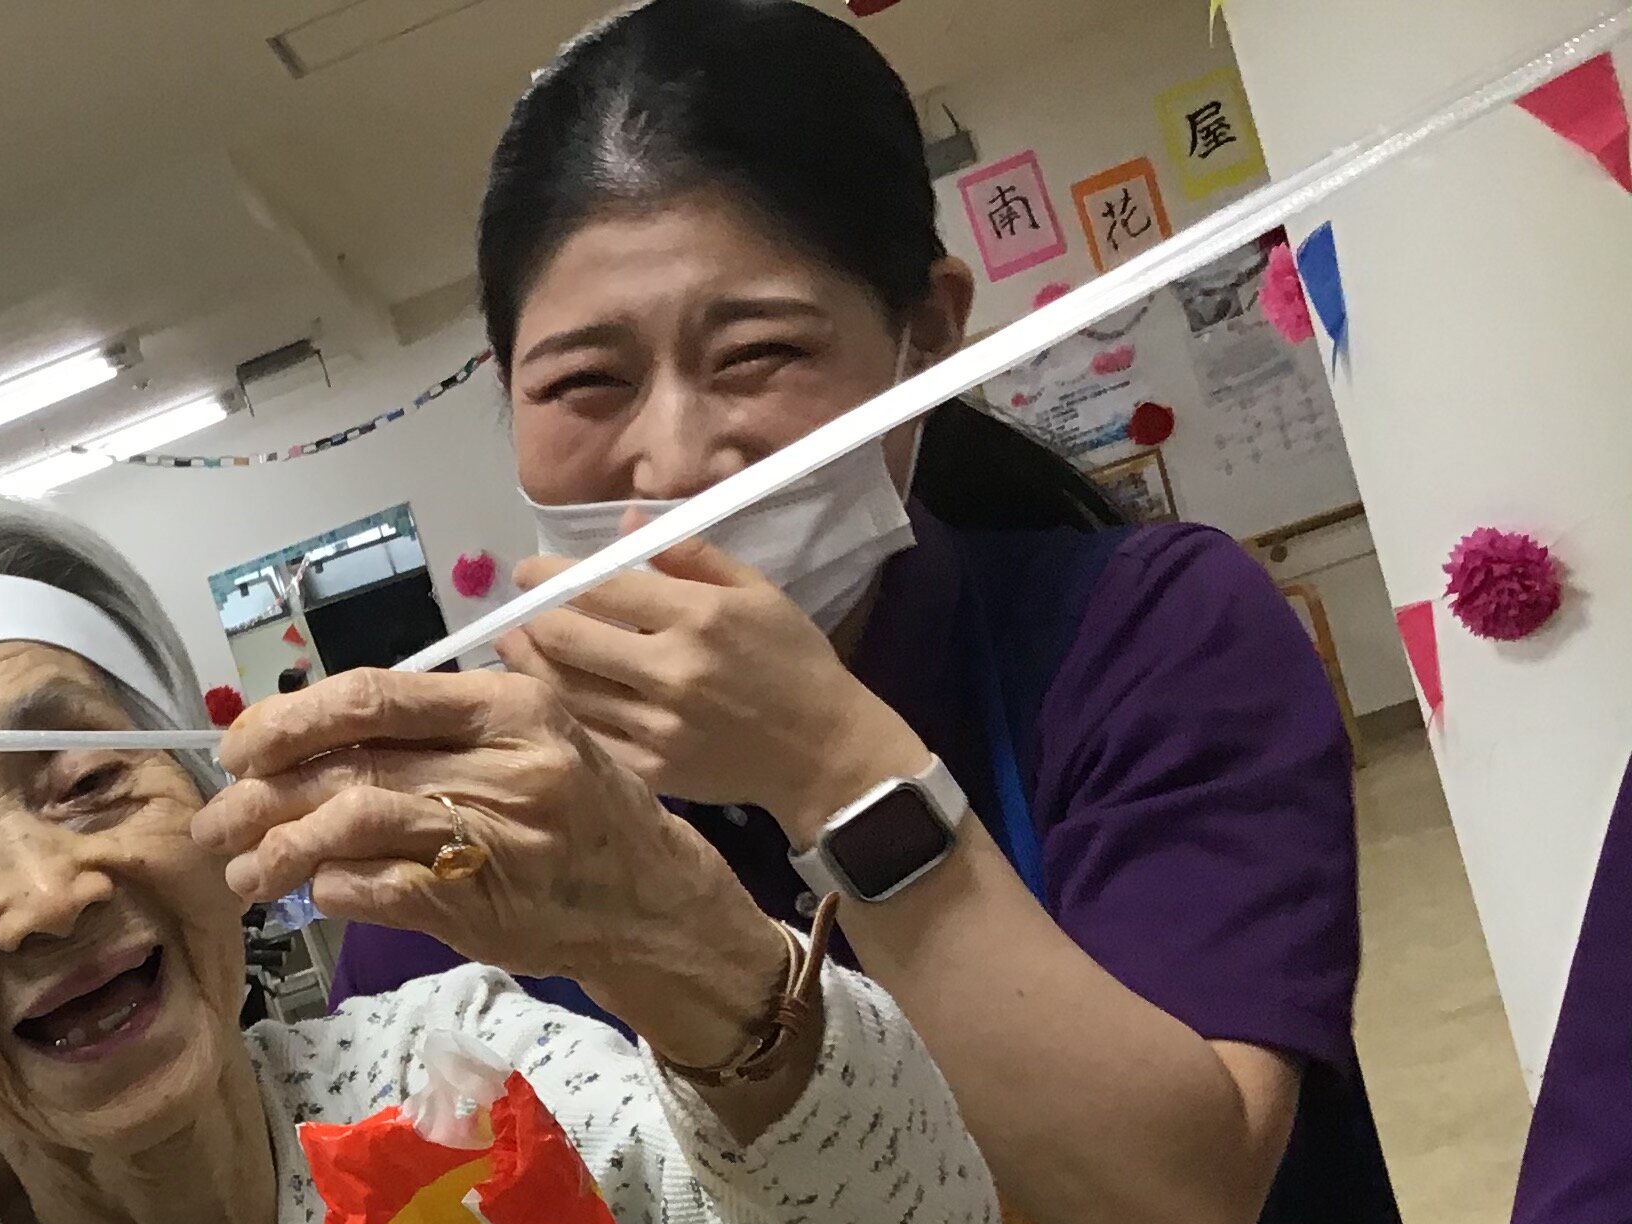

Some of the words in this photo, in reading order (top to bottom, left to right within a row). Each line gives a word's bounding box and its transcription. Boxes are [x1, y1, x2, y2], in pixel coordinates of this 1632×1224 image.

[988, 184, 1041, 240] 南
[1100, 187, 1152, 252] 花
[1184, 100, 1238, 160] 屋
